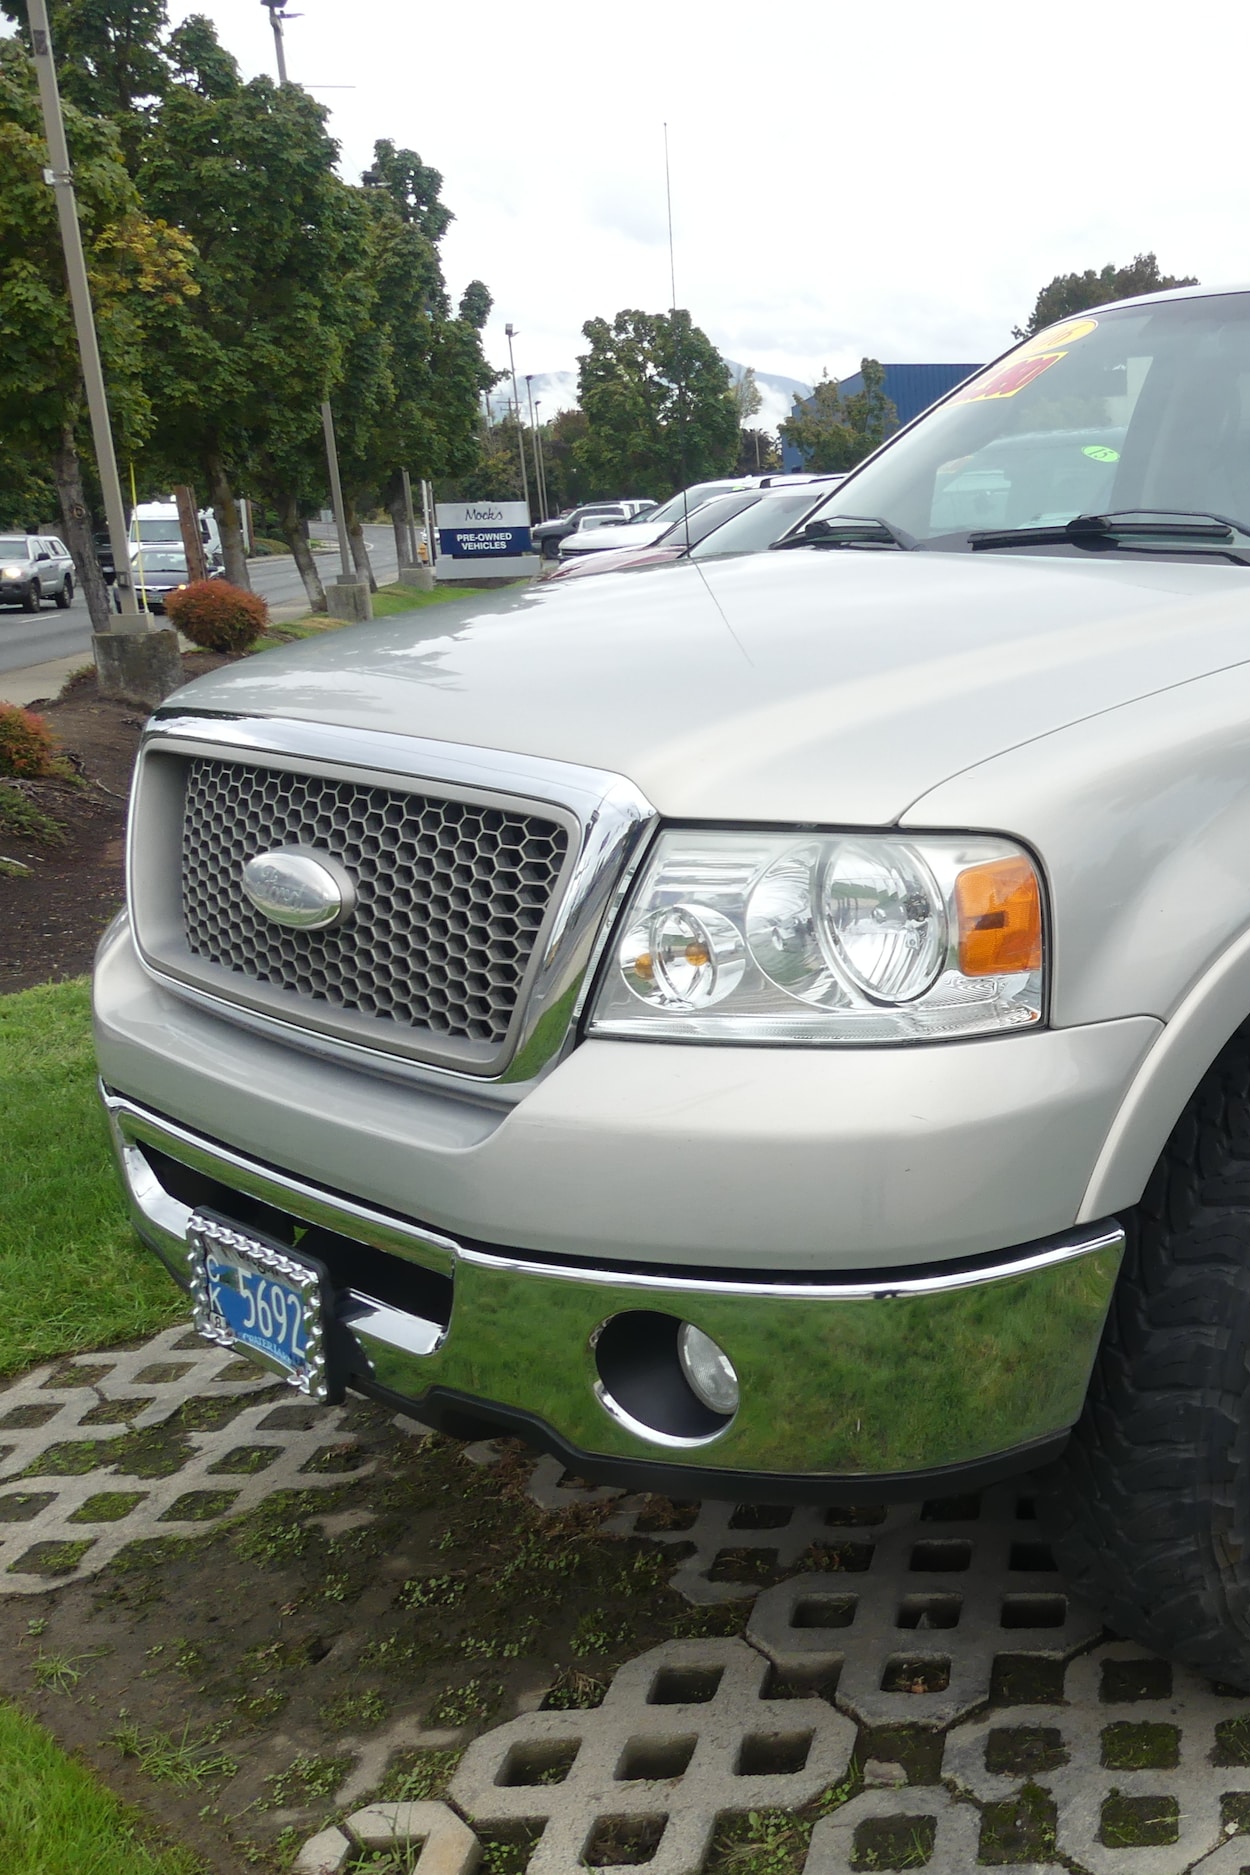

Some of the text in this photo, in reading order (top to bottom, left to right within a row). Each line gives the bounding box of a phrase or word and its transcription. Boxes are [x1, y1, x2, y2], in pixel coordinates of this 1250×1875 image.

[457, 532, 512, 541] PRE-OWNED
[461, 542, 507, 550] VEHICLES
[237, 1266, 306, 1358] 5692
